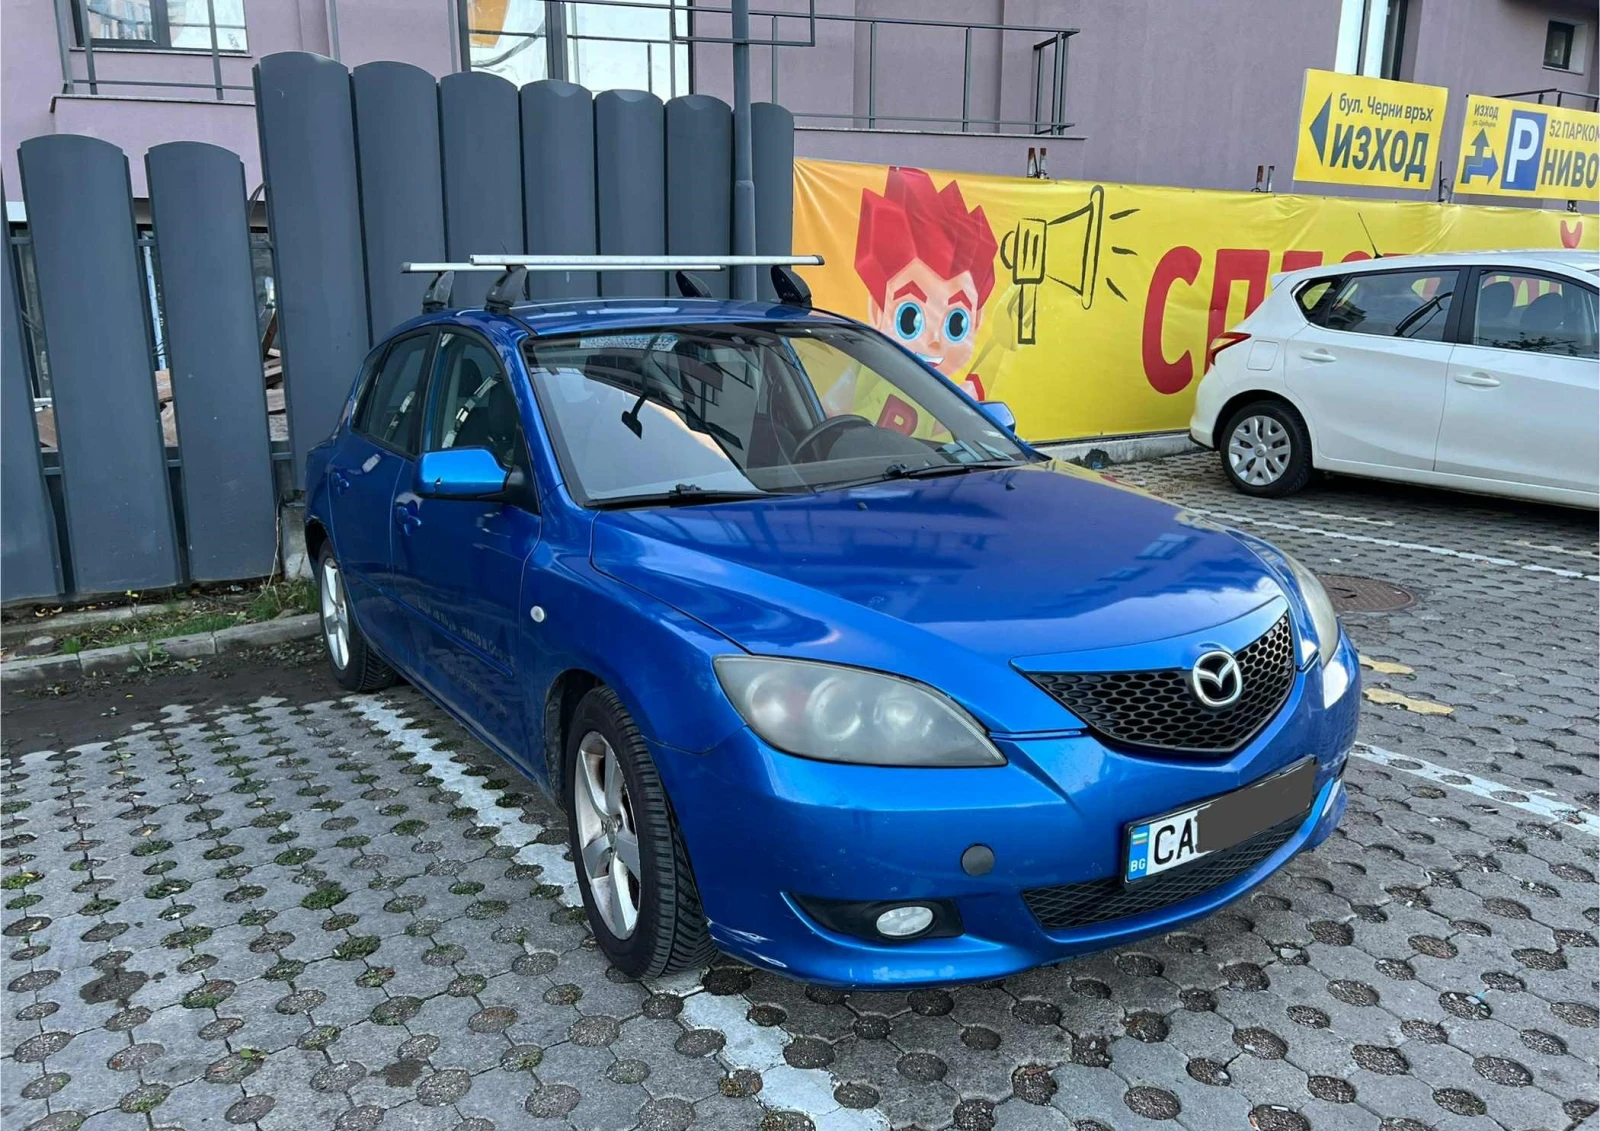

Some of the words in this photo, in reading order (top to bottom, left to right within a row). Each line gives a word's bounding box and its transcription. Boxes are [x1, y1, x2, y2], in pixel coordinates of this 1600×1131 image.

[1339, 93, 1363, 113] бул.
[1367, 96, 1402, 121] Черни
[1405, 105, 1434, 123] връх
[1474, 104, 1499, 121] ИЗХОД
[1549, 119, 1561, 138] 52
[1330, 123, 1428, 182] ИЗХОД
[1541, 148, 1599, 189] НИВО
[1154, 819, 1193, 865] CA
[1130, 858, 1146, 872] BG
